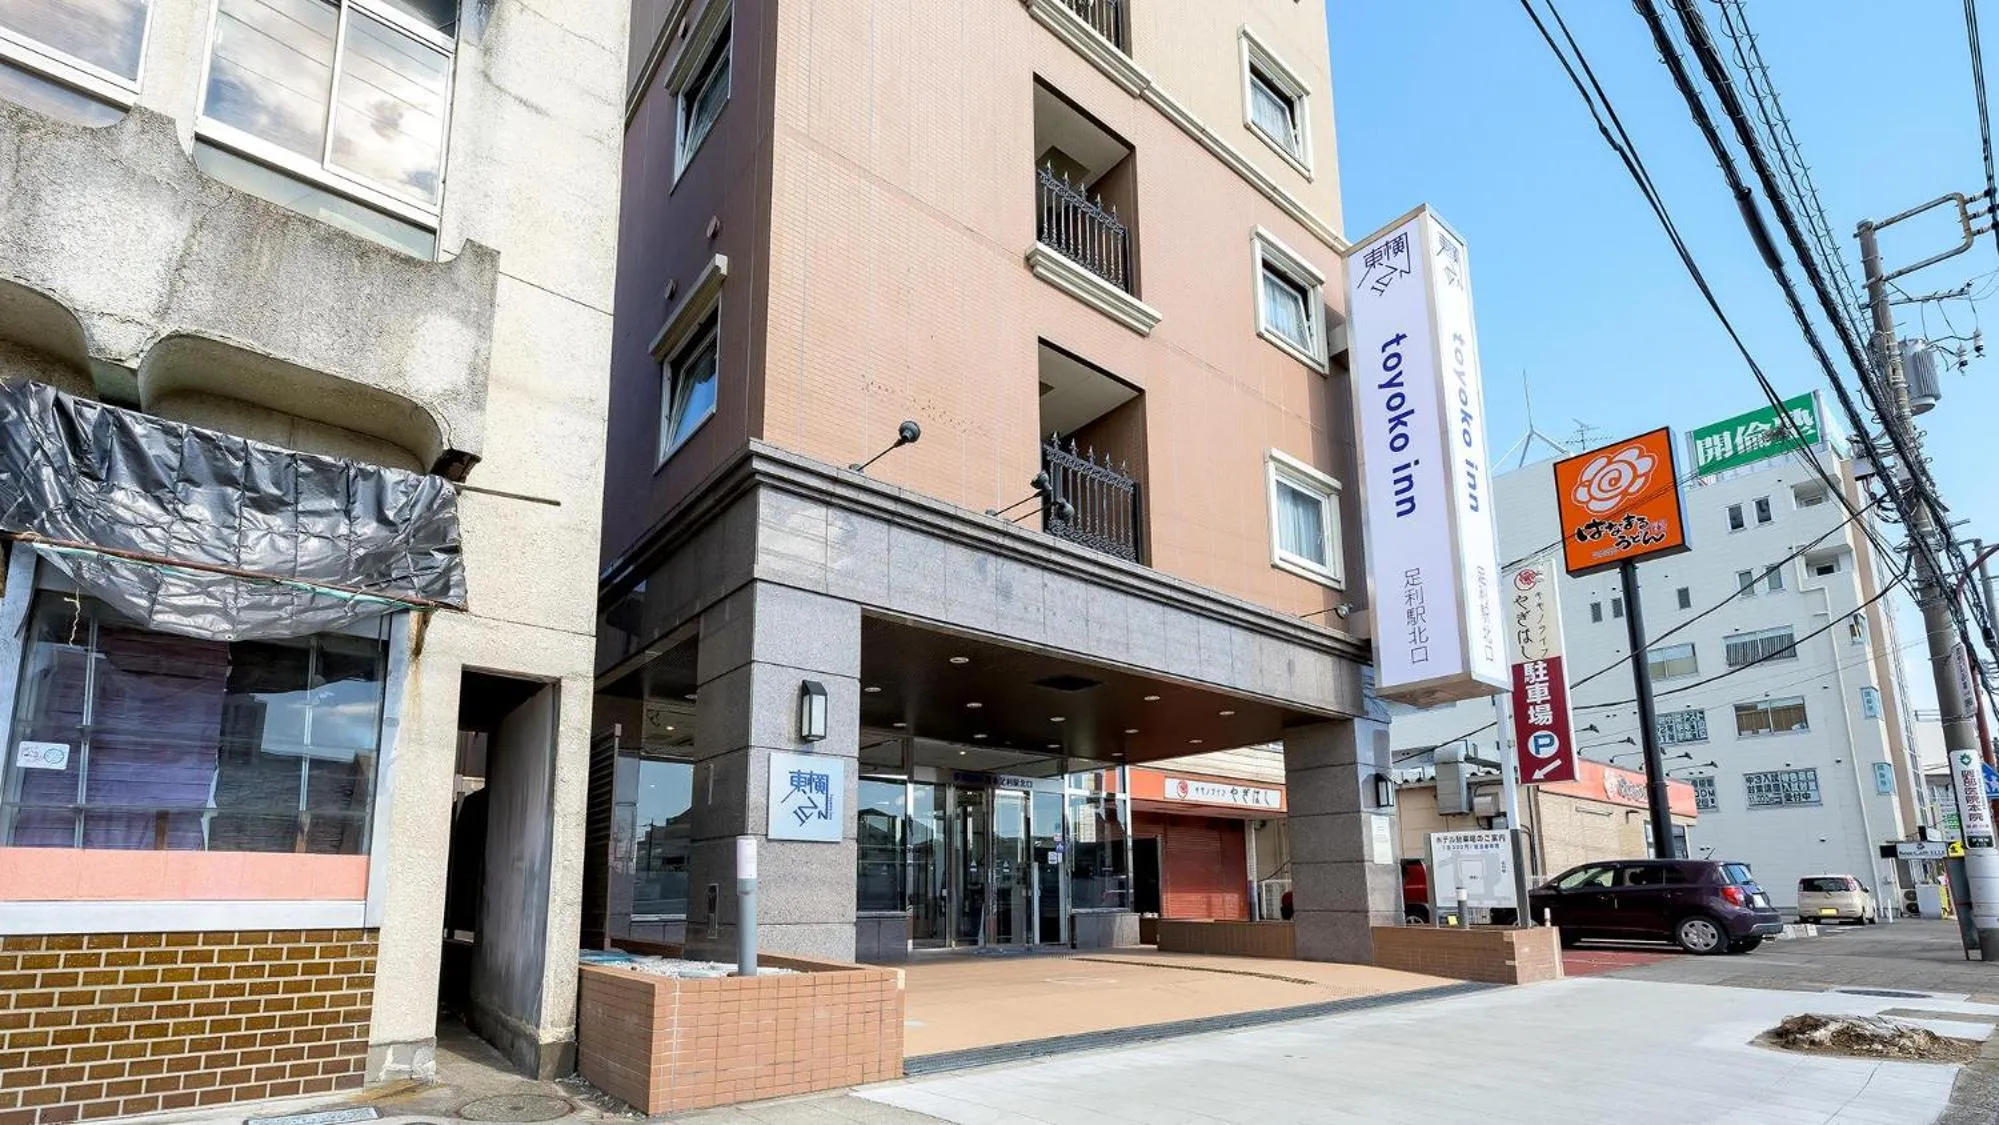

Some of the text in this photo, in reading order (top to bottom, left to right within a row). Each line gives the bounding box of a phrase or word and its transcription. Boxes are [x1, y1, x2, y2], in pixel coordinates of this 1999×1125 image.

[1377, 332, 1420, 518] toyoko inn
[1452, 332, 1480, 513] toyoko inn
[1575, 512, 1650, 542] はなまる
[1613, 530, 1667, 551] うどん
[1404, 567, 1430, 664] 足利駅北口
[1513, 594, 1533, 660] やぎはし
[1523, 660, 1553, 726] 駐車場
[1533, 732, 1555, 756] P
[1230, 786, 1270, 806] やぎはし
